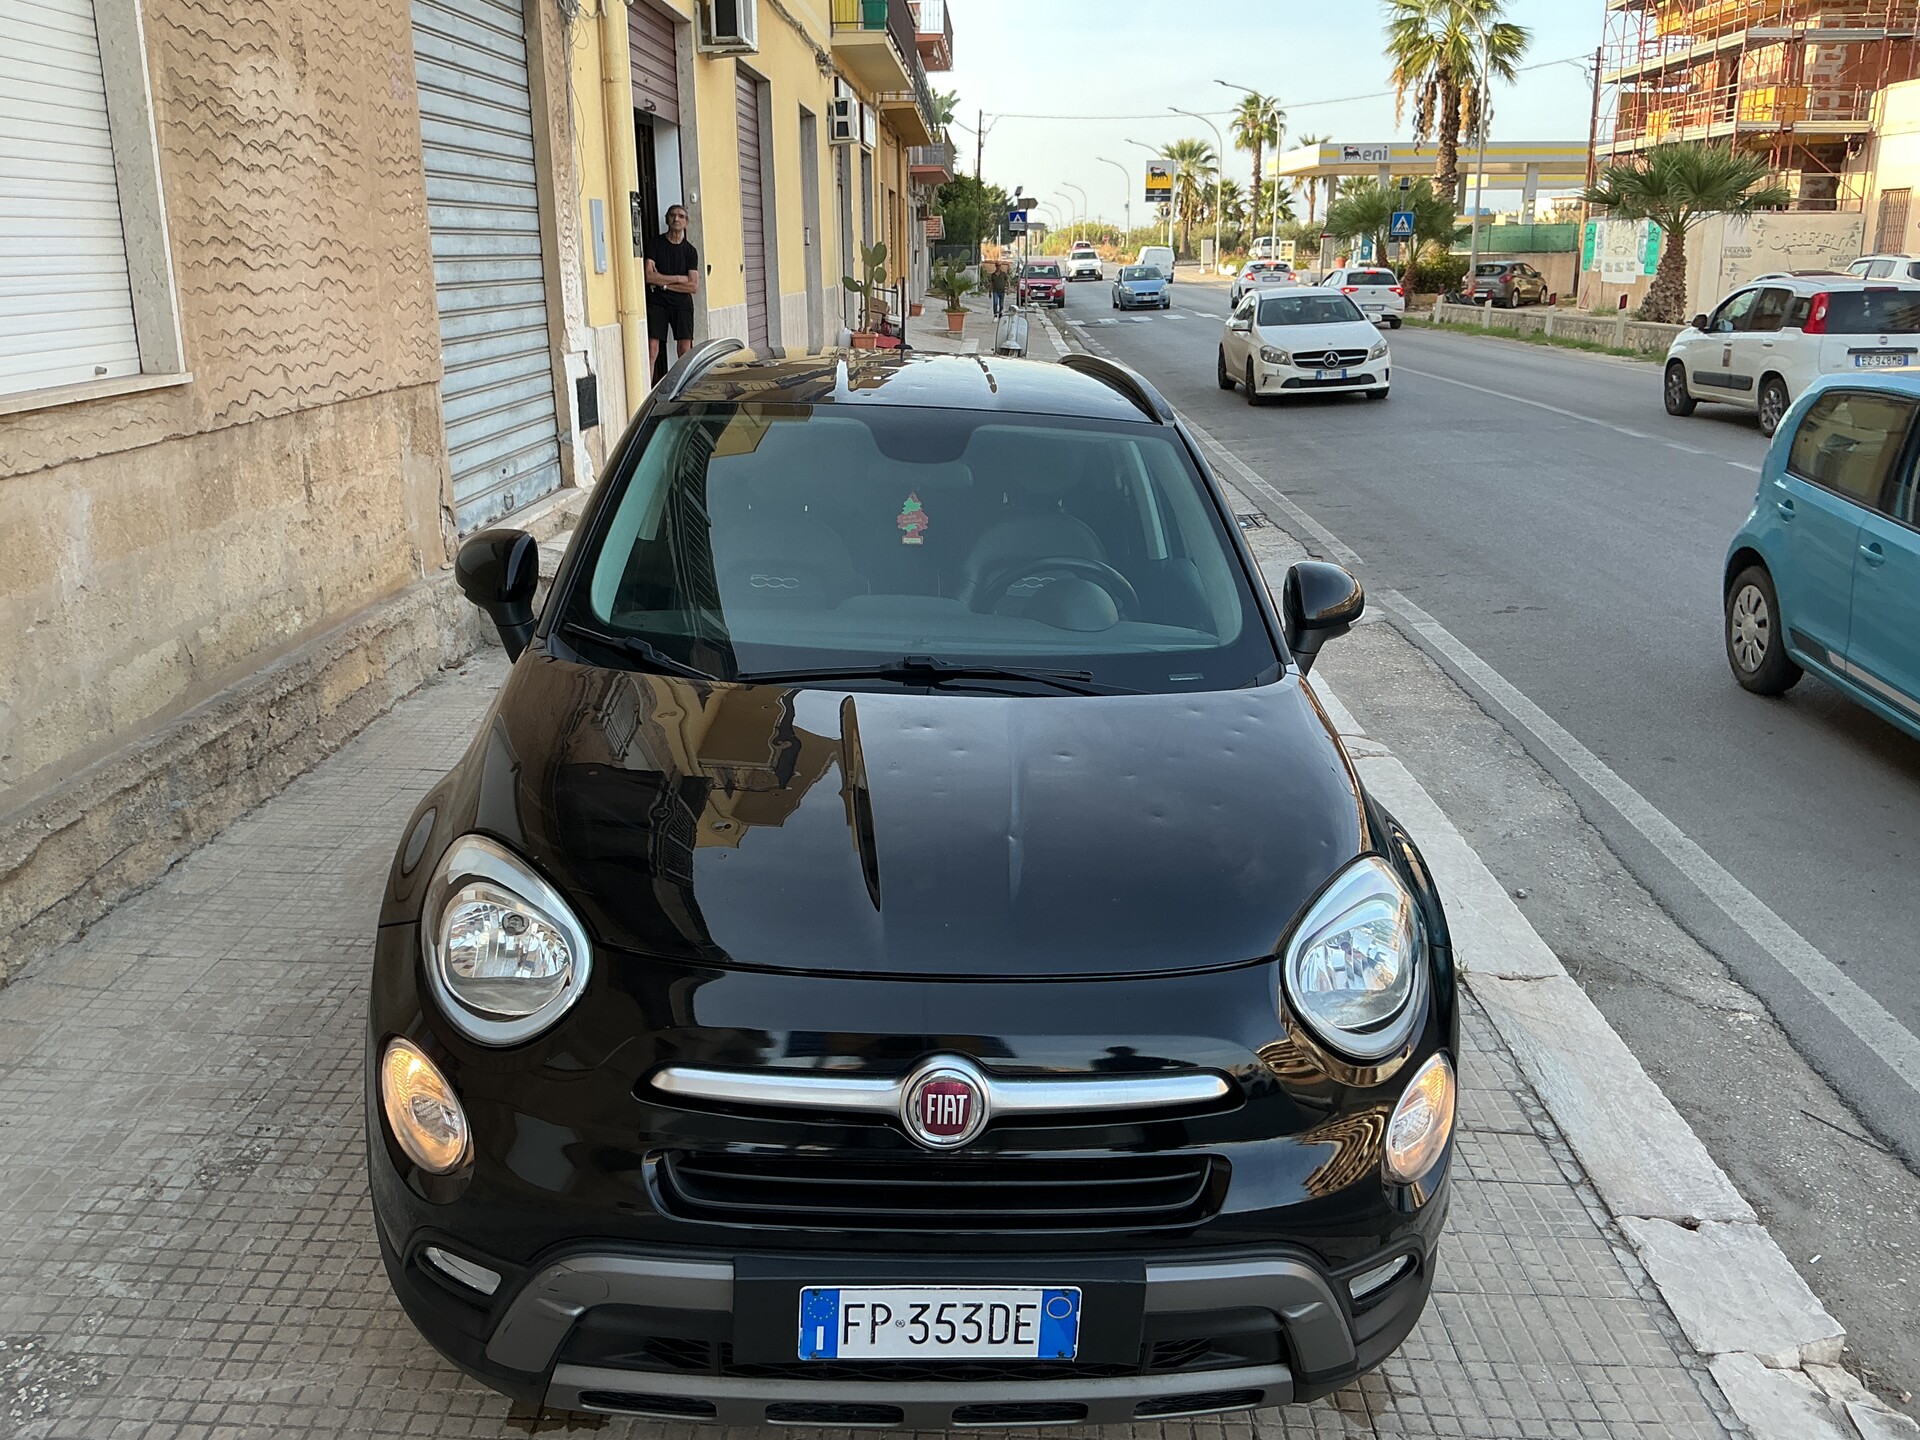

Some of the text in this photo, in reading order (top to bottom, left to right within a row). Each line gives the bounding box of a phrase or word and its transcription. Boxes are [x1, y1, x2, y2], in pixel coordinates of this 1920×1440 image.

[1362, 145, 1388, 161] eni
[926, 1093, 968, 1125] FIAT
[842, 1302, 1037, 1345] FP 353DE
